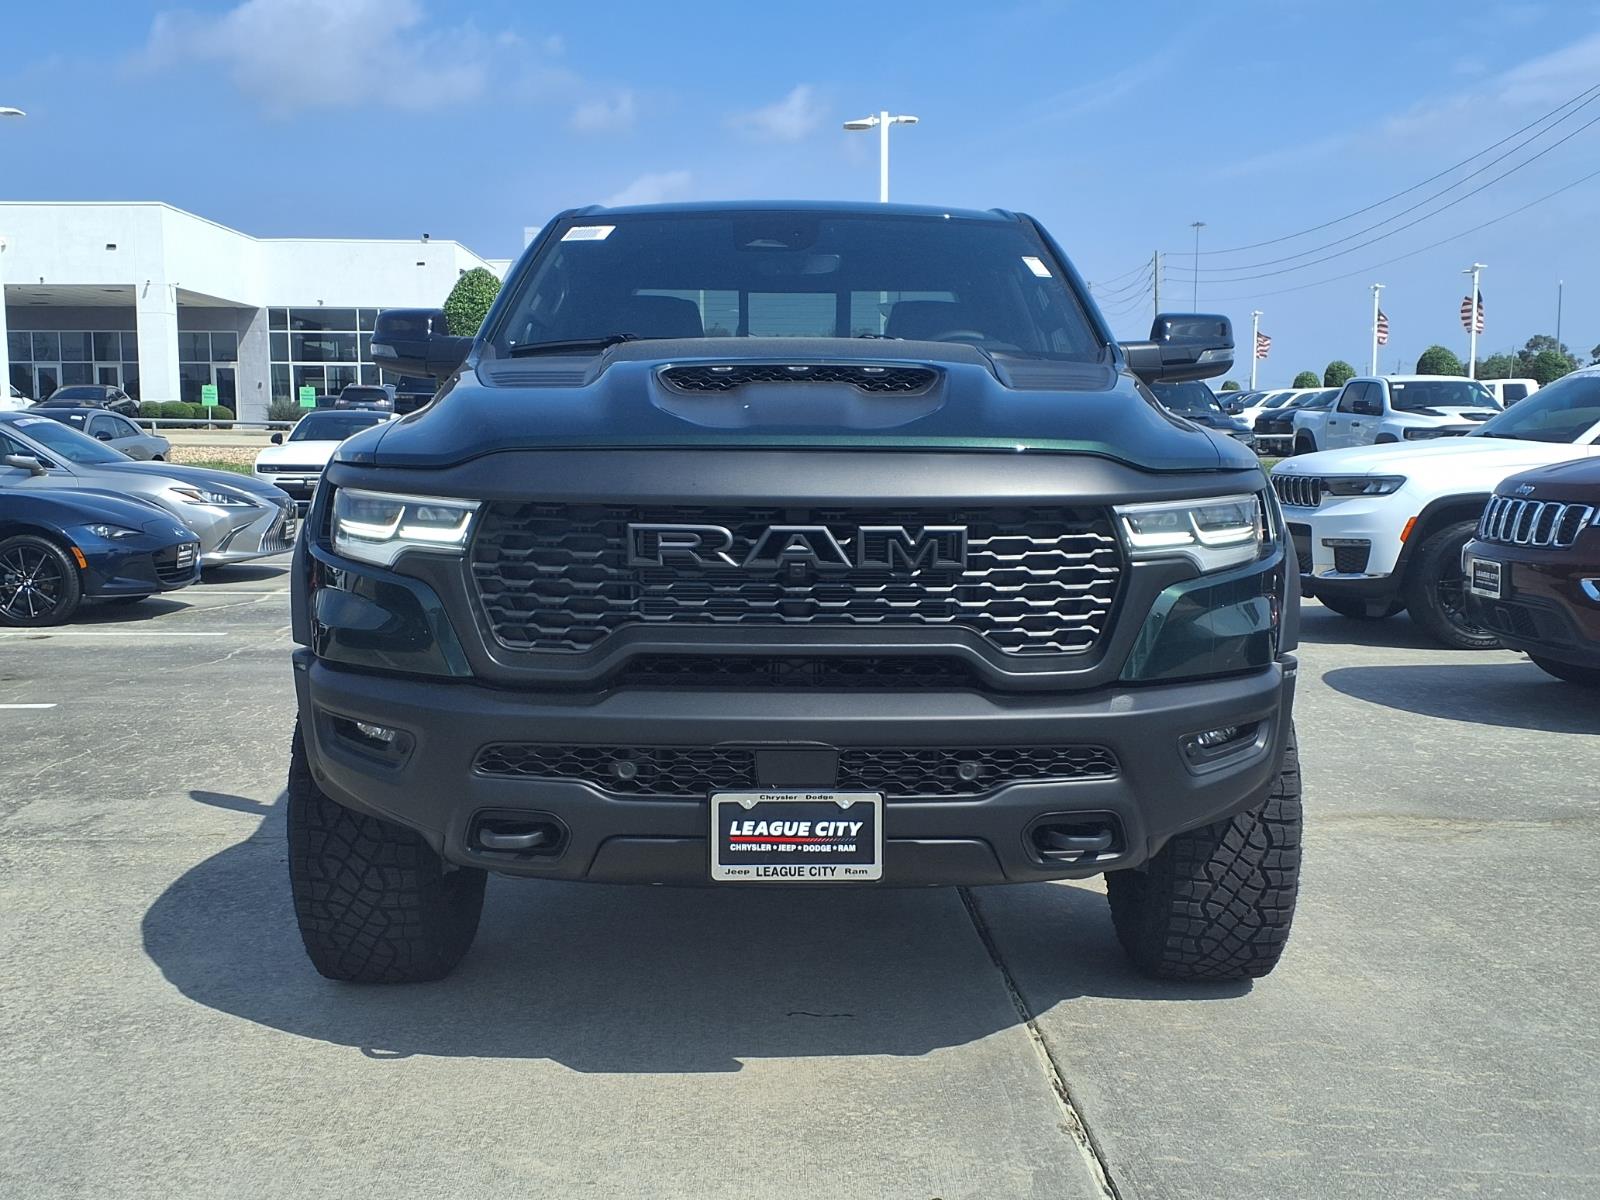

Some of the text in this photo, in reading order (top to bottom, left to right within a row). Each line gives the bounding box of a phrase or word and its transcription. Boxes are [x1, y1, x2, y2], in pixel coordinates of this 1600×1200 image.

[627, 523, 968, 568] RAM
[730, 820, 863, 837] LEAGUE CITY
[730, 843, 856, 852] CHRYSLER JEEP DODGE RAM
[724, 866, 868, 877] Jeep LEAGUE CITY Ram
